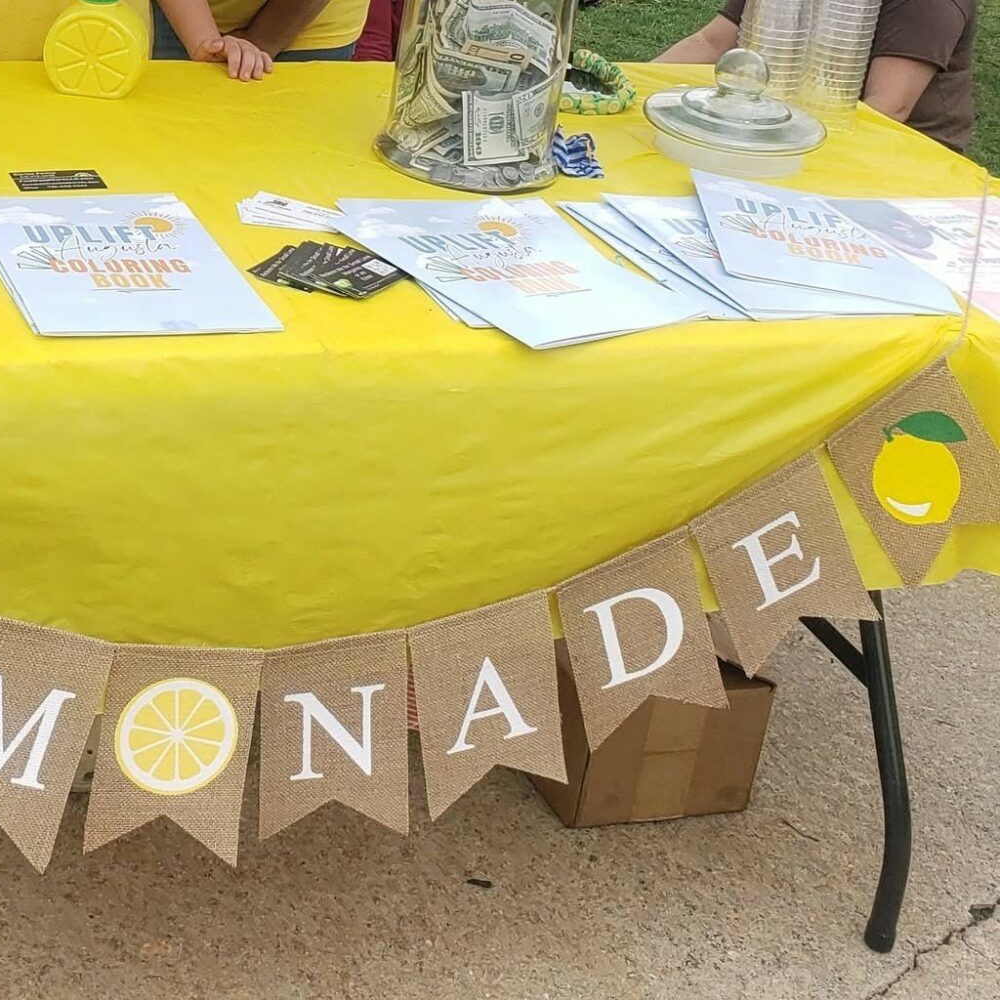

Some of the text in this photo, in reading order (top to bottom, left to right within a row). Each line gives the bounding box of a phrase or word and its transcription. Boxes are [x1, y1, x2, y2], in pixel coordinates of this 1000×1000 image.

[734, 197, 845, 228] UPLIF
[22, 224, 157, 244] UPLIFT
[749, 227, 889, 260] COLORING
[50, 258, 192, 273] COLORING
[90, 273, 172, 289] BOOK
